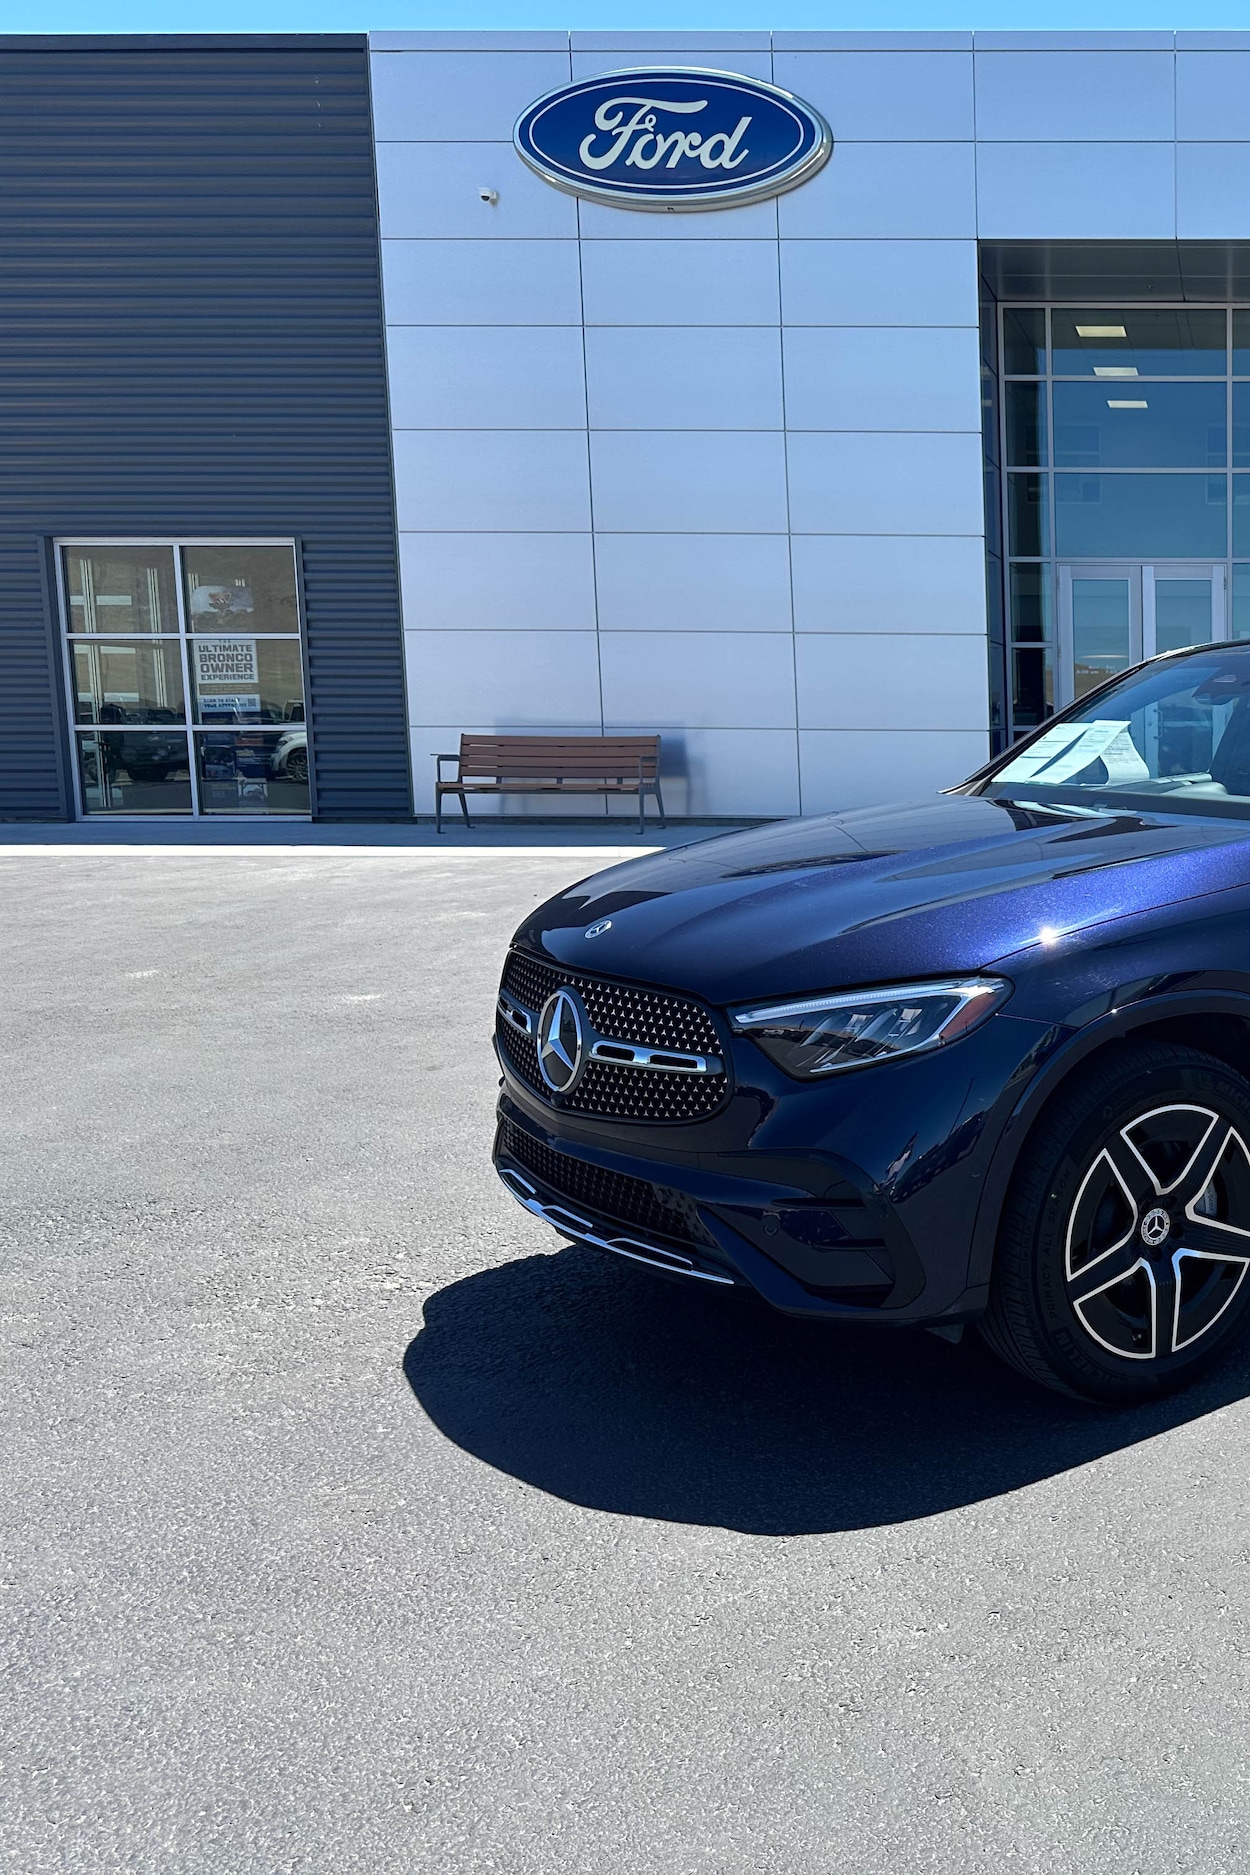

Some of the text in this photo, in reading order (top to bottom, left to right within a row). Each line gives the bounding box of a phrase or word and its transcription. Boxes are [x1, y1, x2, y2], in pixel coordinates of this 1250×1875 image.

[579, 97, 752, 170] Ford
[198, 644, 253, 653] ULTIMATE
[199, 653, 253, 663] BRONCO
[200, 663, 254, 673] OWNER
[201, 673, 255, 681] EXPERIENCE
[1042, 1232, 1054, 1257] ALL
[1041, 1263, 1057, 1320] PRIMACY
